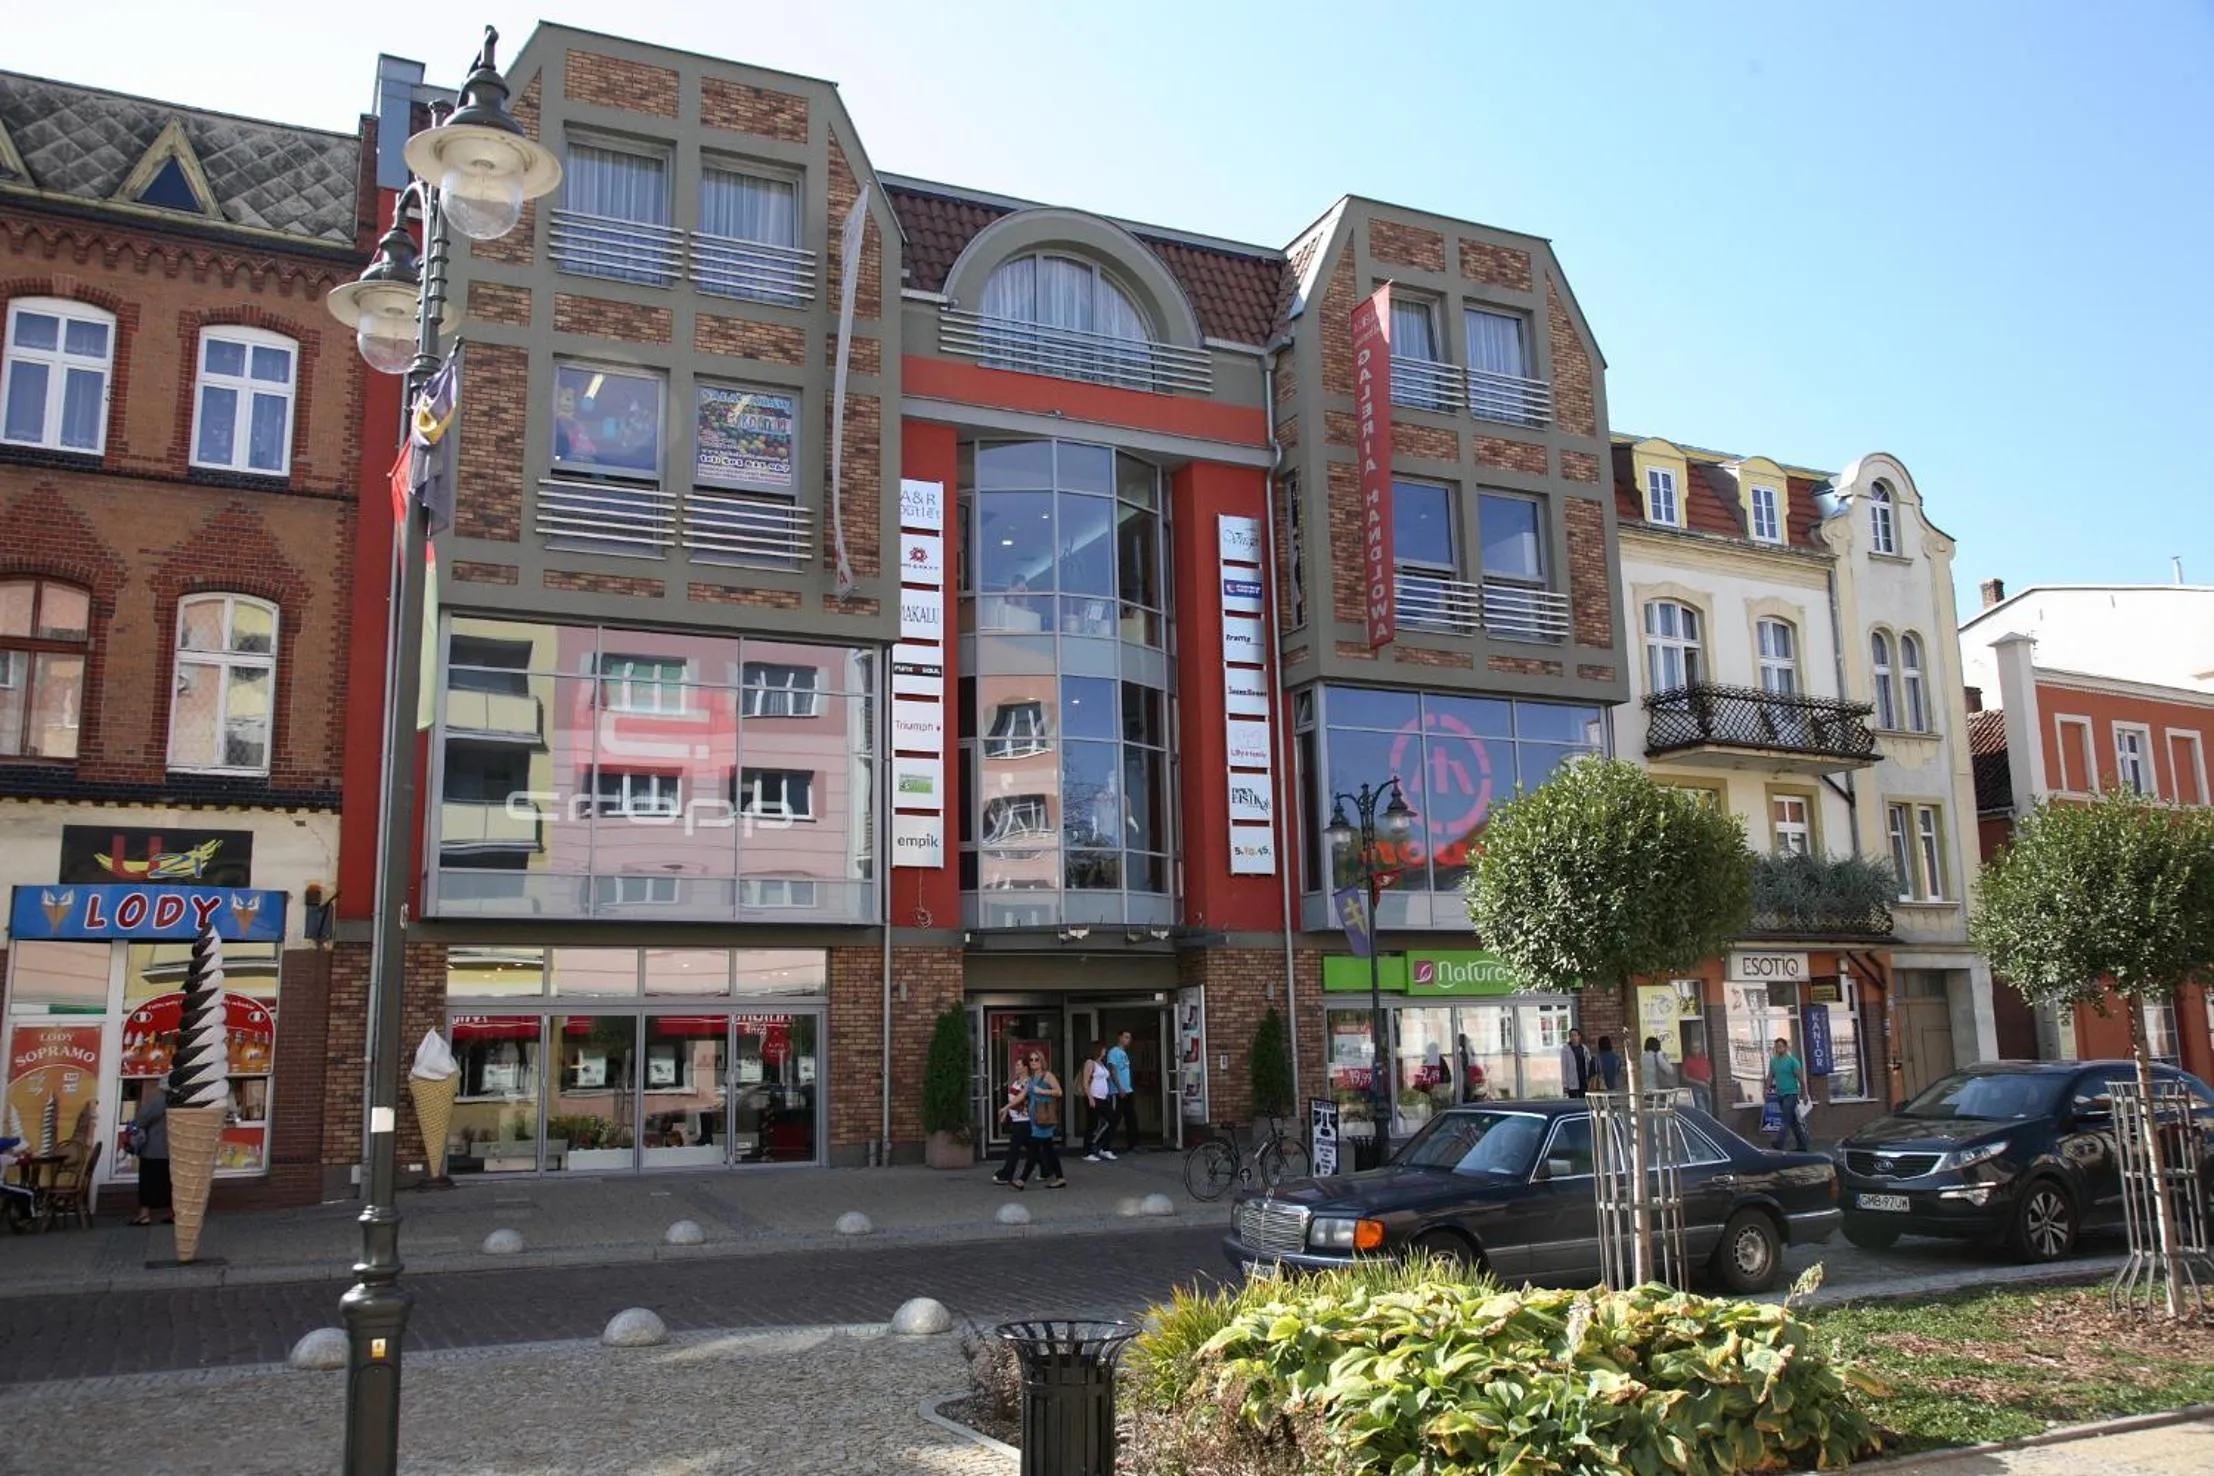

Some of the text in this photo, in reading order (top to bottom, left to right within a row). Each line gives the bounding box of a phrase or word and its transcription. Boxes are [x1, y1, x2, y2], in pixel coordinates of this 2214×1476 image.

[505, 790, 794, 838] cropp
[897, 833, 938, 849] empik
[85, 893, 222, 929] LODY
[1743, 956, 1799, 977] ESOTIQ
[1811, 1012, 1823, 1067] KANTOR
